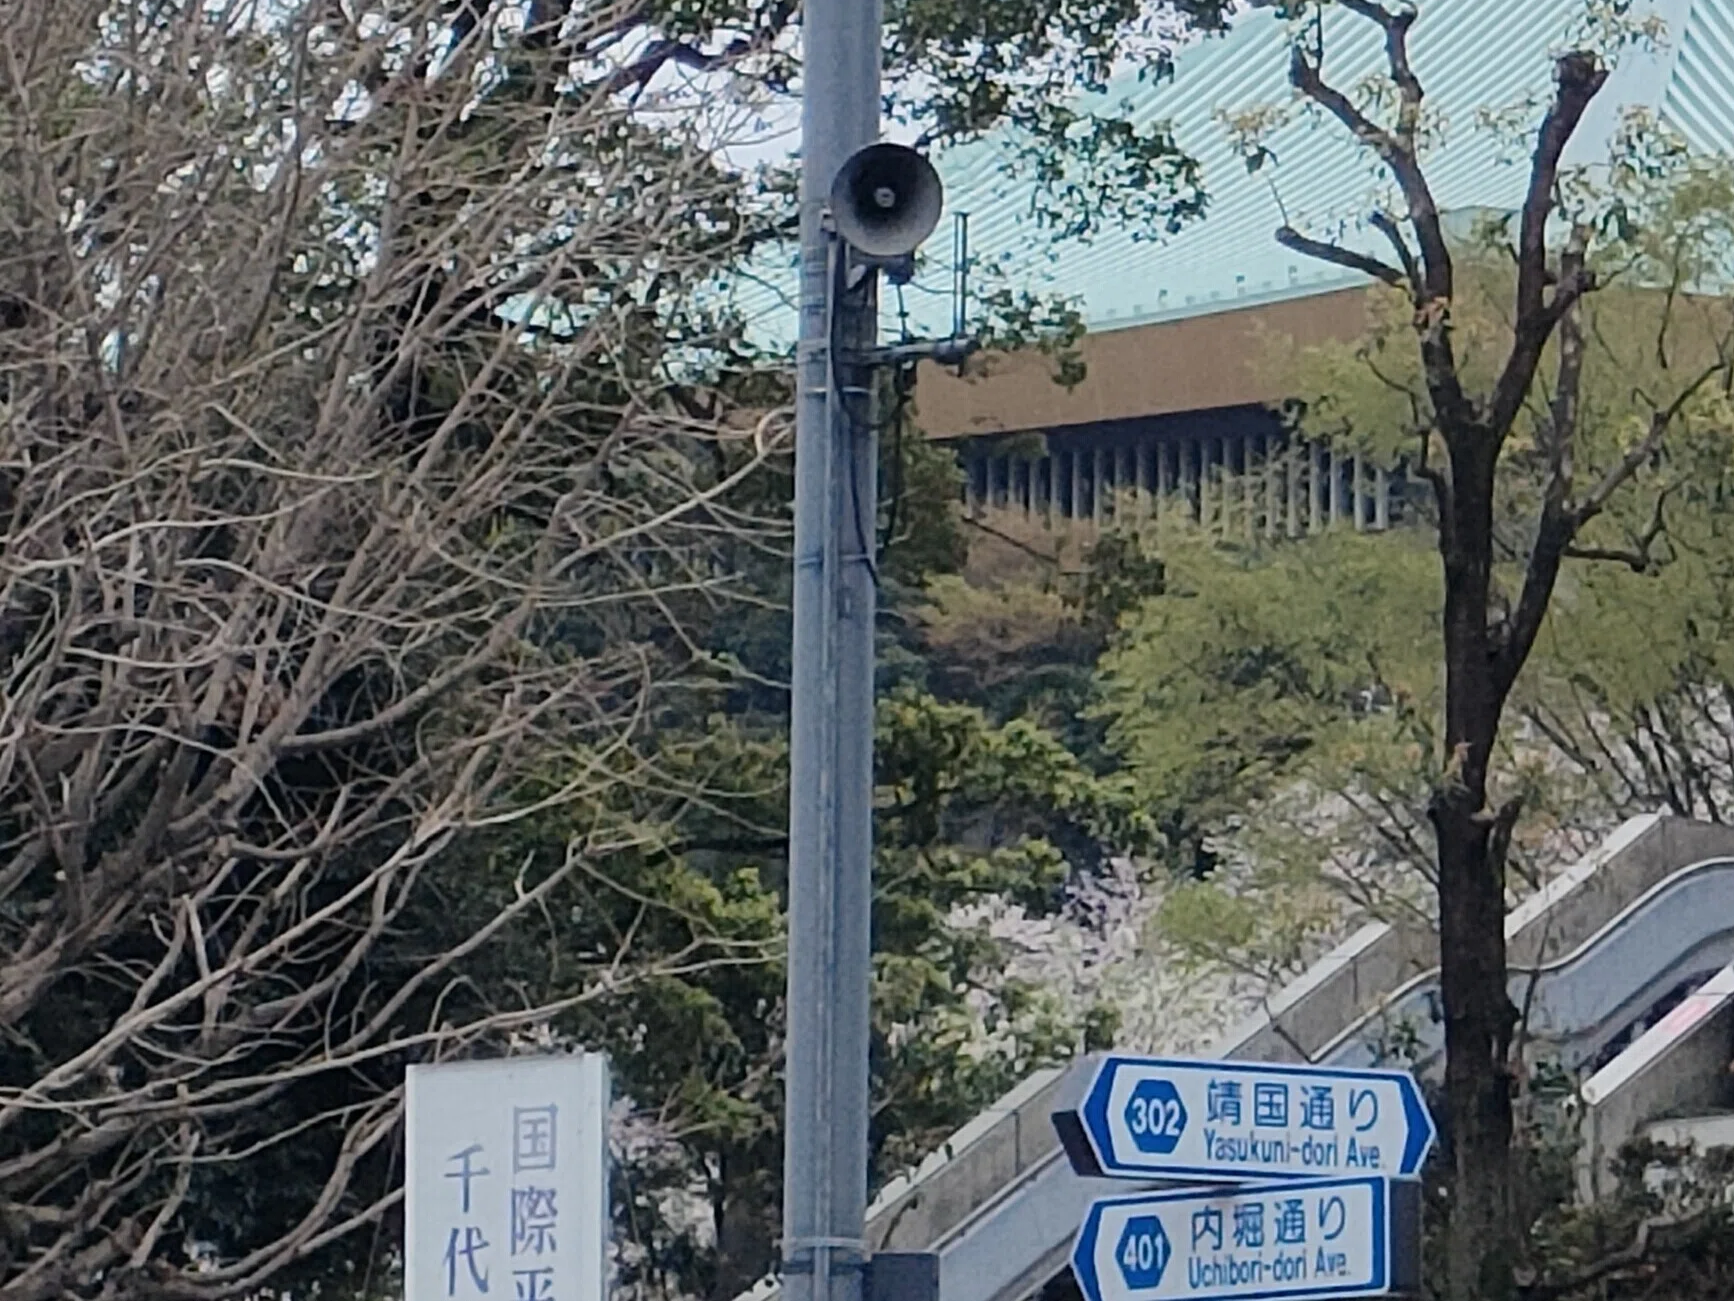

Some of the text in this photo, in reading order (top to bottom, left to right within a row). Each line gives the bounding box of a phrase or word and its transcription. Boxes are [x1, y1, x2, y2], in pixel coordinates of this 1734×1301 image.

[1132, 1099, 1180, 1137] 302
[1207, 1078, 1379, 1132] 靖国通り
[1203, 1127, 1339, 1168] Yasukuni-dori
[442, 1143, 491, 1297] 千代
[1191, 1195, 1346, 1252] 内堀通り
[1123, 1233, 1164, 1273] 401
[1188, 1251, 1308, 1288] Uchibori-dori
